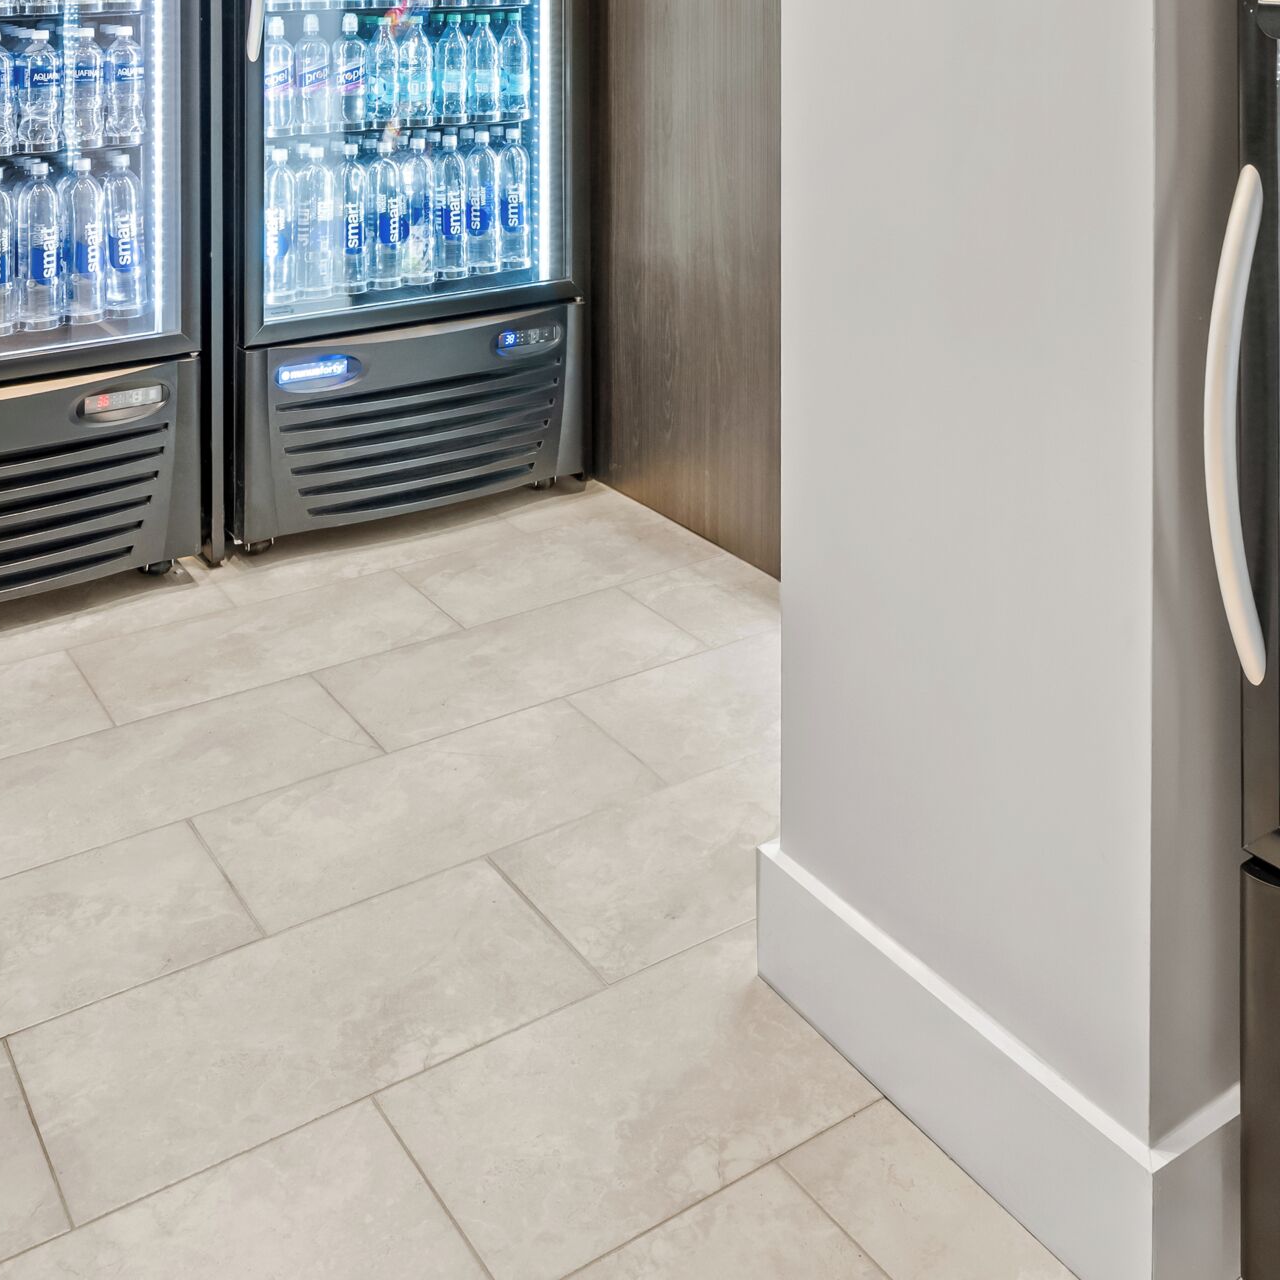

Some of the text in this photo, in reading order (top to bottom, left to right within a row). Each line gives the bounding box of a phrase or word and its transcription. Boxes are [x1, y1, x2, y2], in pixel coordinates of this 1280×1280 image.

[346, 202, 360, 249] smart
[450, 190, 463, 236] smart
[508, 184, 520, 228] smart
[117, 214, 131, 266] smart
[505, 332, 515, 346] 38
[97, 393, 110, 409] 36
